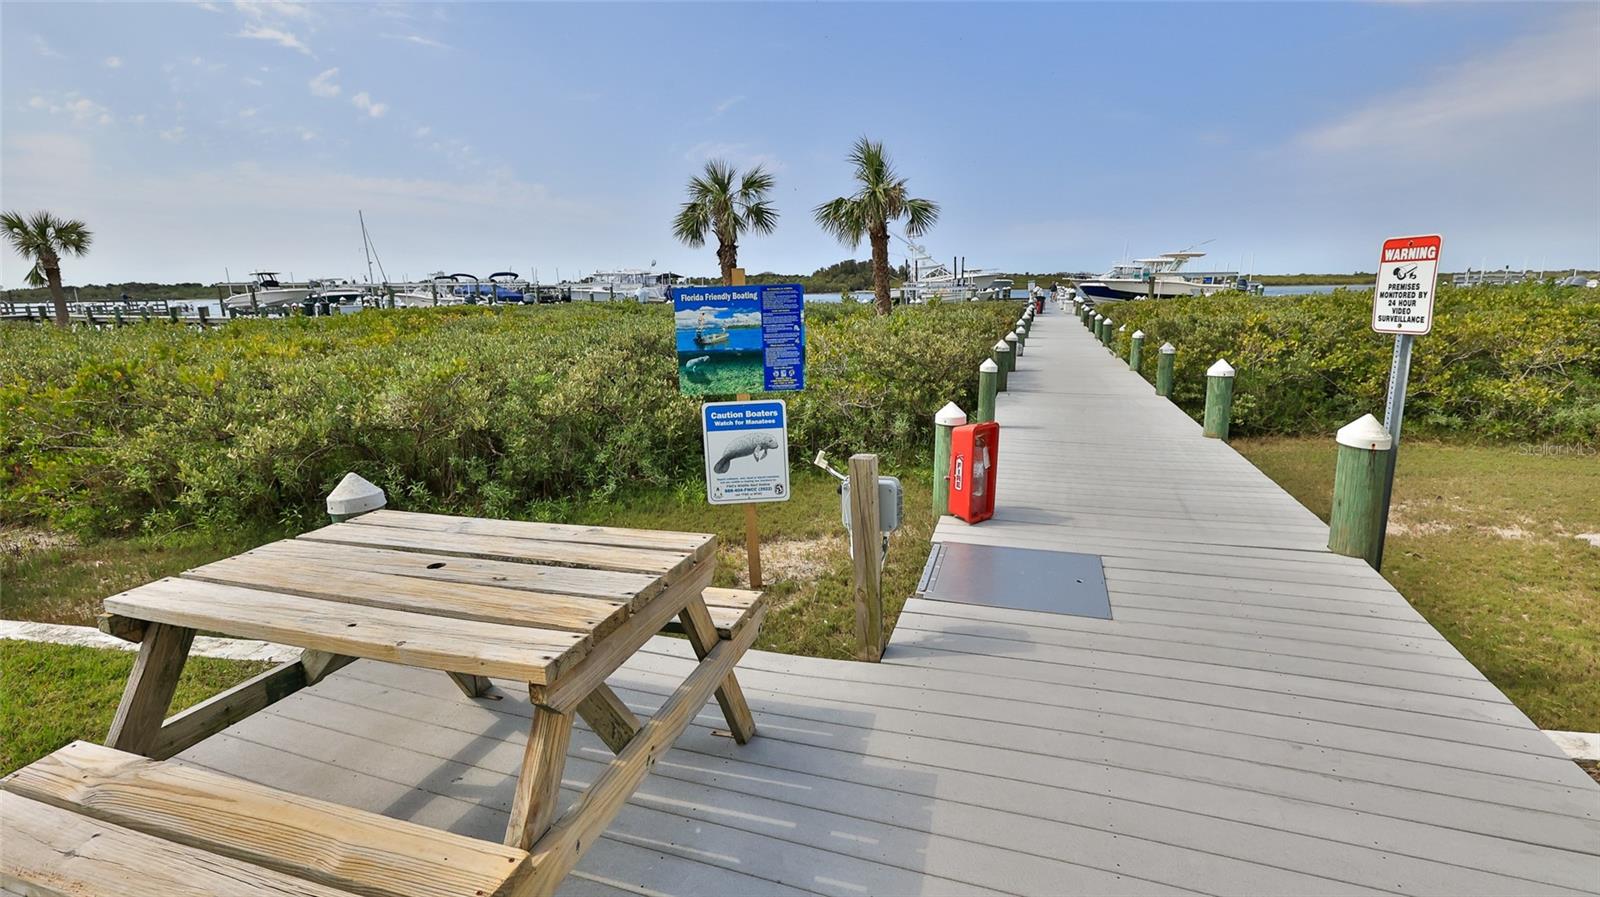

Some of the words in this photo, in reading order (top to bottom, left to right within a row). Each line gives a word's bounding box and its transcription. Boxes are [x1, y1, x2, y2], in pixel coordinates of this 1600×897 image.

[1384, 246, 1436, 261] WARNING
[1387, 283, 1420, 291] PREMISES
[680, 293, 704, 302] Florida
[705, 292, 731, 302] Friendly
[732, 291, 758, 301] Boating
[1377, 315, 1425, 323] SURVEILLANCE
[710, 411, 743, 420] Caution
[745, 410, 778, 418] Boaters
